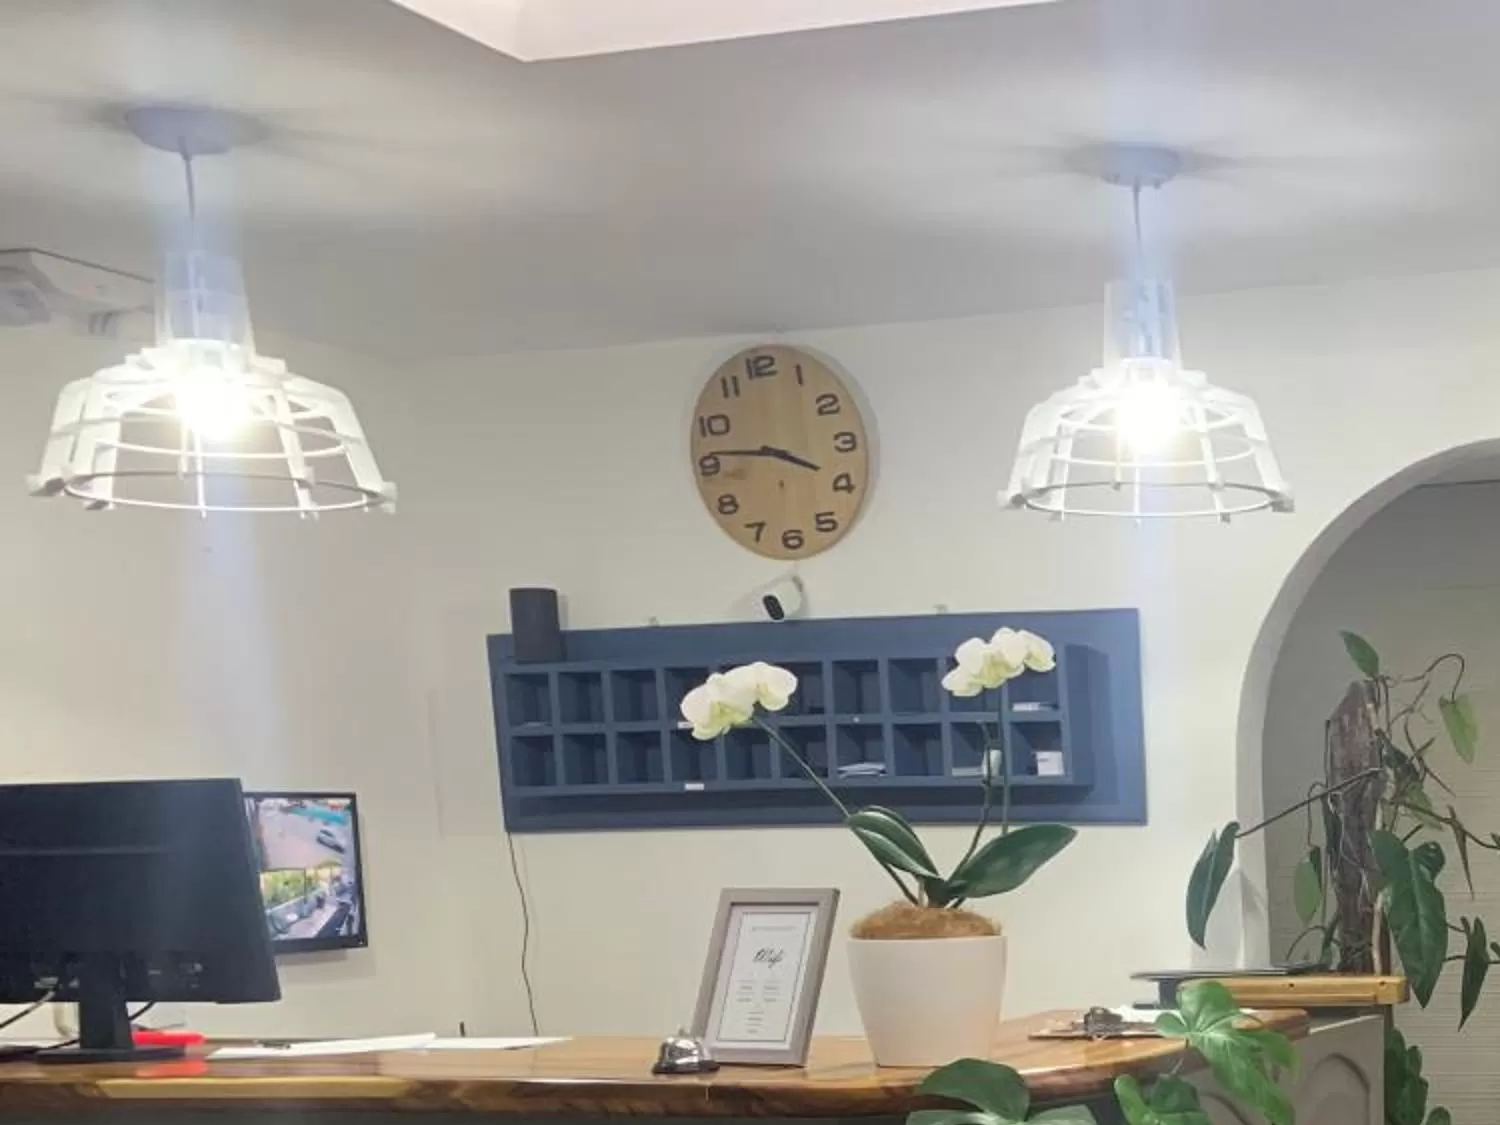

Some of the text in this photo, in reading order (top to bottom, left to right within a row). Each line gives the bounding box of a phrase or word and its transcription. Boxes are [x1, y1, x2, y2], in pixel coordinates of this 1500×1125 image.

[745, 355, 778, 381] 12
[794, 364, 804, 385] 1
[721, 376, 740, 398] 11
[816, 394, 840, 416] 2
[699, 414, 731, 438] 10
[833, 432, 857, 452] 3
[699, 454, 720, 476] 9
[833, 473, 856, 495] 4
[717, 494, 740, 515] 8
[744, 521, 766, 543] 7
[814, 511, 839, 532] 5
[782, 529, 805, 550] 6
